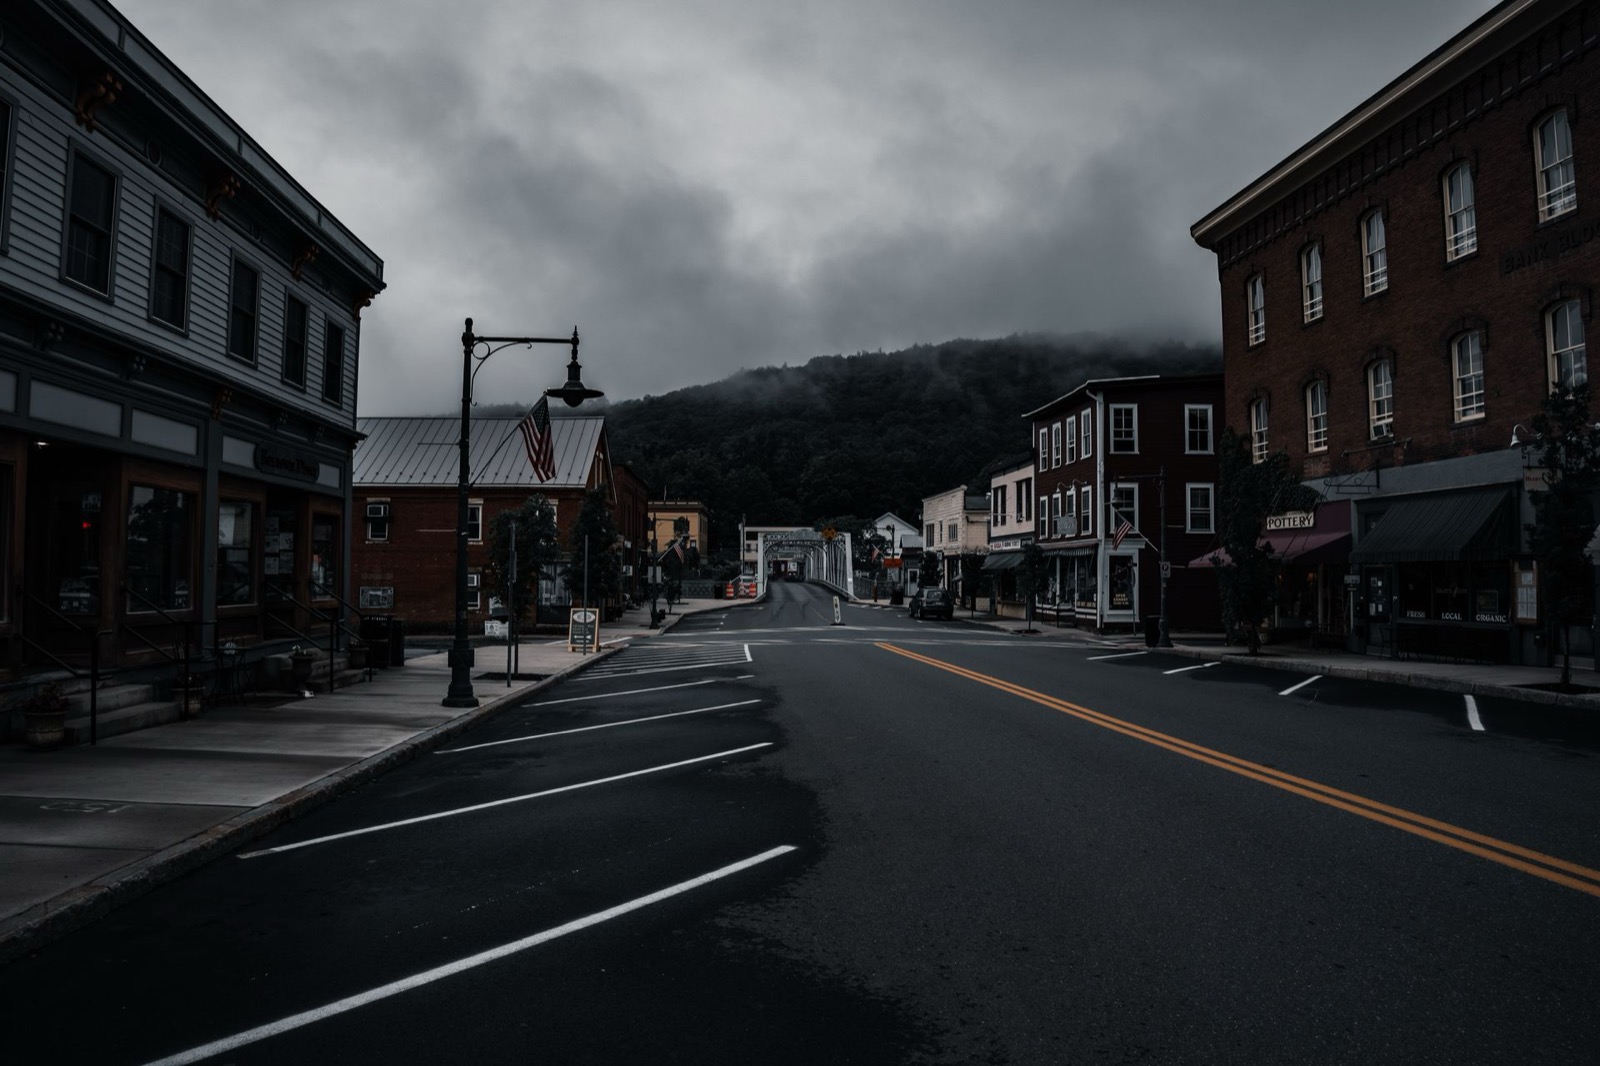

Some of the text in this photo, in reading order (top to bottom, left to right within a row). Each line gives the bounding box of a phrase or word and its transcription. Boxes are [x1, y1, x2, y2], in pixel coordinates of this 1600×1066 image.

[1502, 239, 1549, 274] BANK
[1268, 515, 1313, 529] POTTERY
[1406, 609, 1507, 624] FRESH LOCAL ORGANIC
